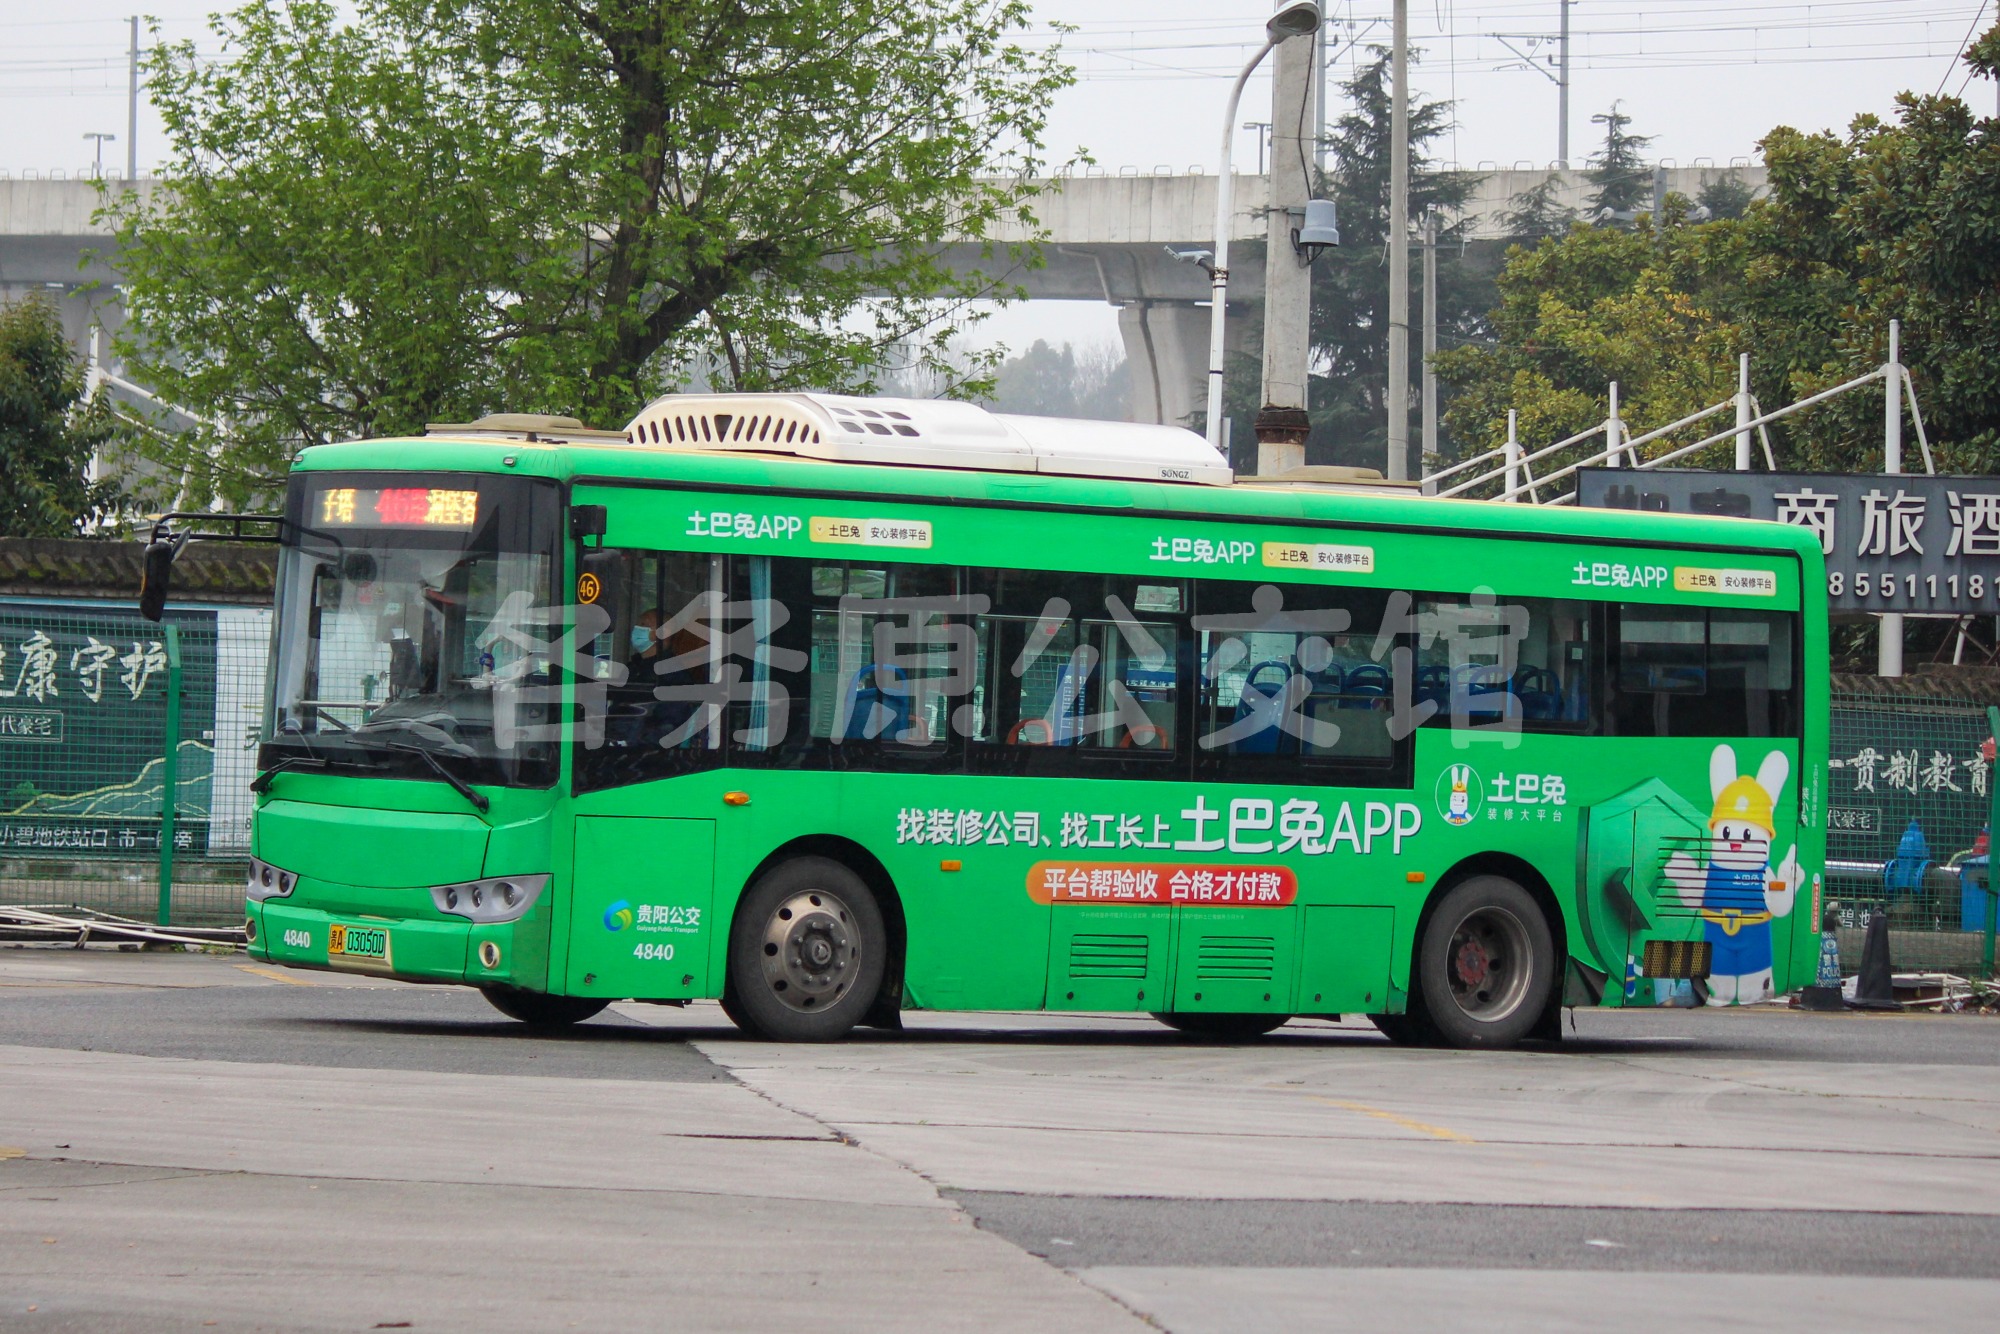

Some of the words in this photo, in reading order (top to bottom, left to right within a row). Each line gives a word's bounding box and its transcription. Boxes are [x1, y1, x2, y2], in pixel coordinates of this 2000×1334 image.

[1161, 468, 1190, 480] SONGZ
[685, 510, 802, 540] 土巴兔APP
[828, 524, 861, 539] 土巴兔
[870, 526, 928, 542] 安心装修平台
[1149, 536, 1256, 565] 土巴兔APP
[1280, 549, 1309, 563] 土巴兔
[1317, 552, 1370, 567] 安心装修平台
[1571, 561, 1668, 589] 土巴兔APP
[1690, 574, 1717, 588] 土巴兔
[1724, 576, 1772, 590] 安心装修平台
[580, 580, 594, 598] 46
[1487, 772, 1567, 806] 土巴兔
[1487, 807, 1563, 823] 装修大平台
[1043, 868, 1160, 899] 平台帮验收
[1168, 869, 1282, 901] 合格才付款
[637, 903, 701, 926] 贵阳公交
[636, 925, 657, 933] Guiyang
[657, 925, 673, 933] Public
[283, 928, 311, 949] 4840
[633, 943, 675, 961] 4840
